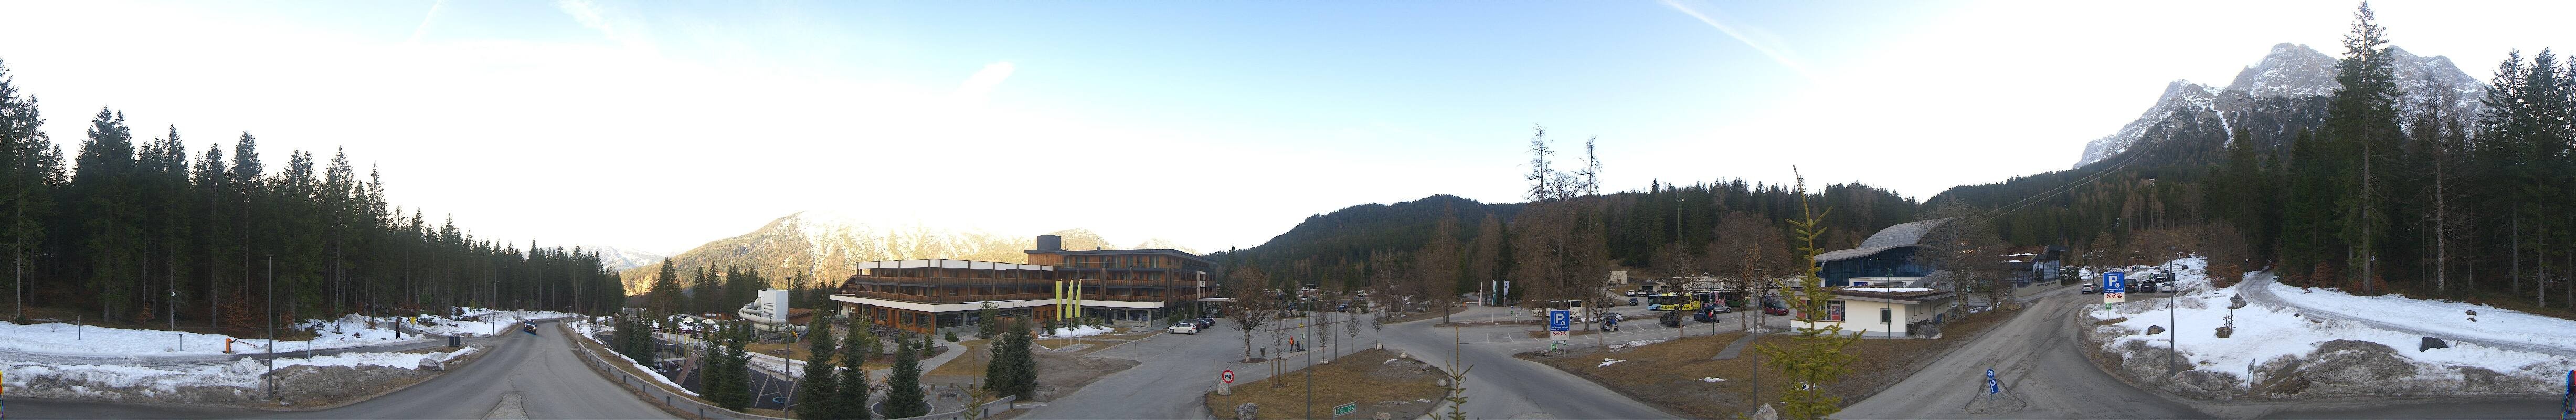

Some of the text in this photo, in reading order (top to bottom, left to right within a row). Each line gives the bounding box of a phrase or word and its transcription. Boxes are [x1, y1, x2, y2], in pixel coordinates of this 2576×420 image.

[2109, 276, 2117, 286] P
[1556, 314, 1564, 323] P
[1990, 380, 1996, 393] P
